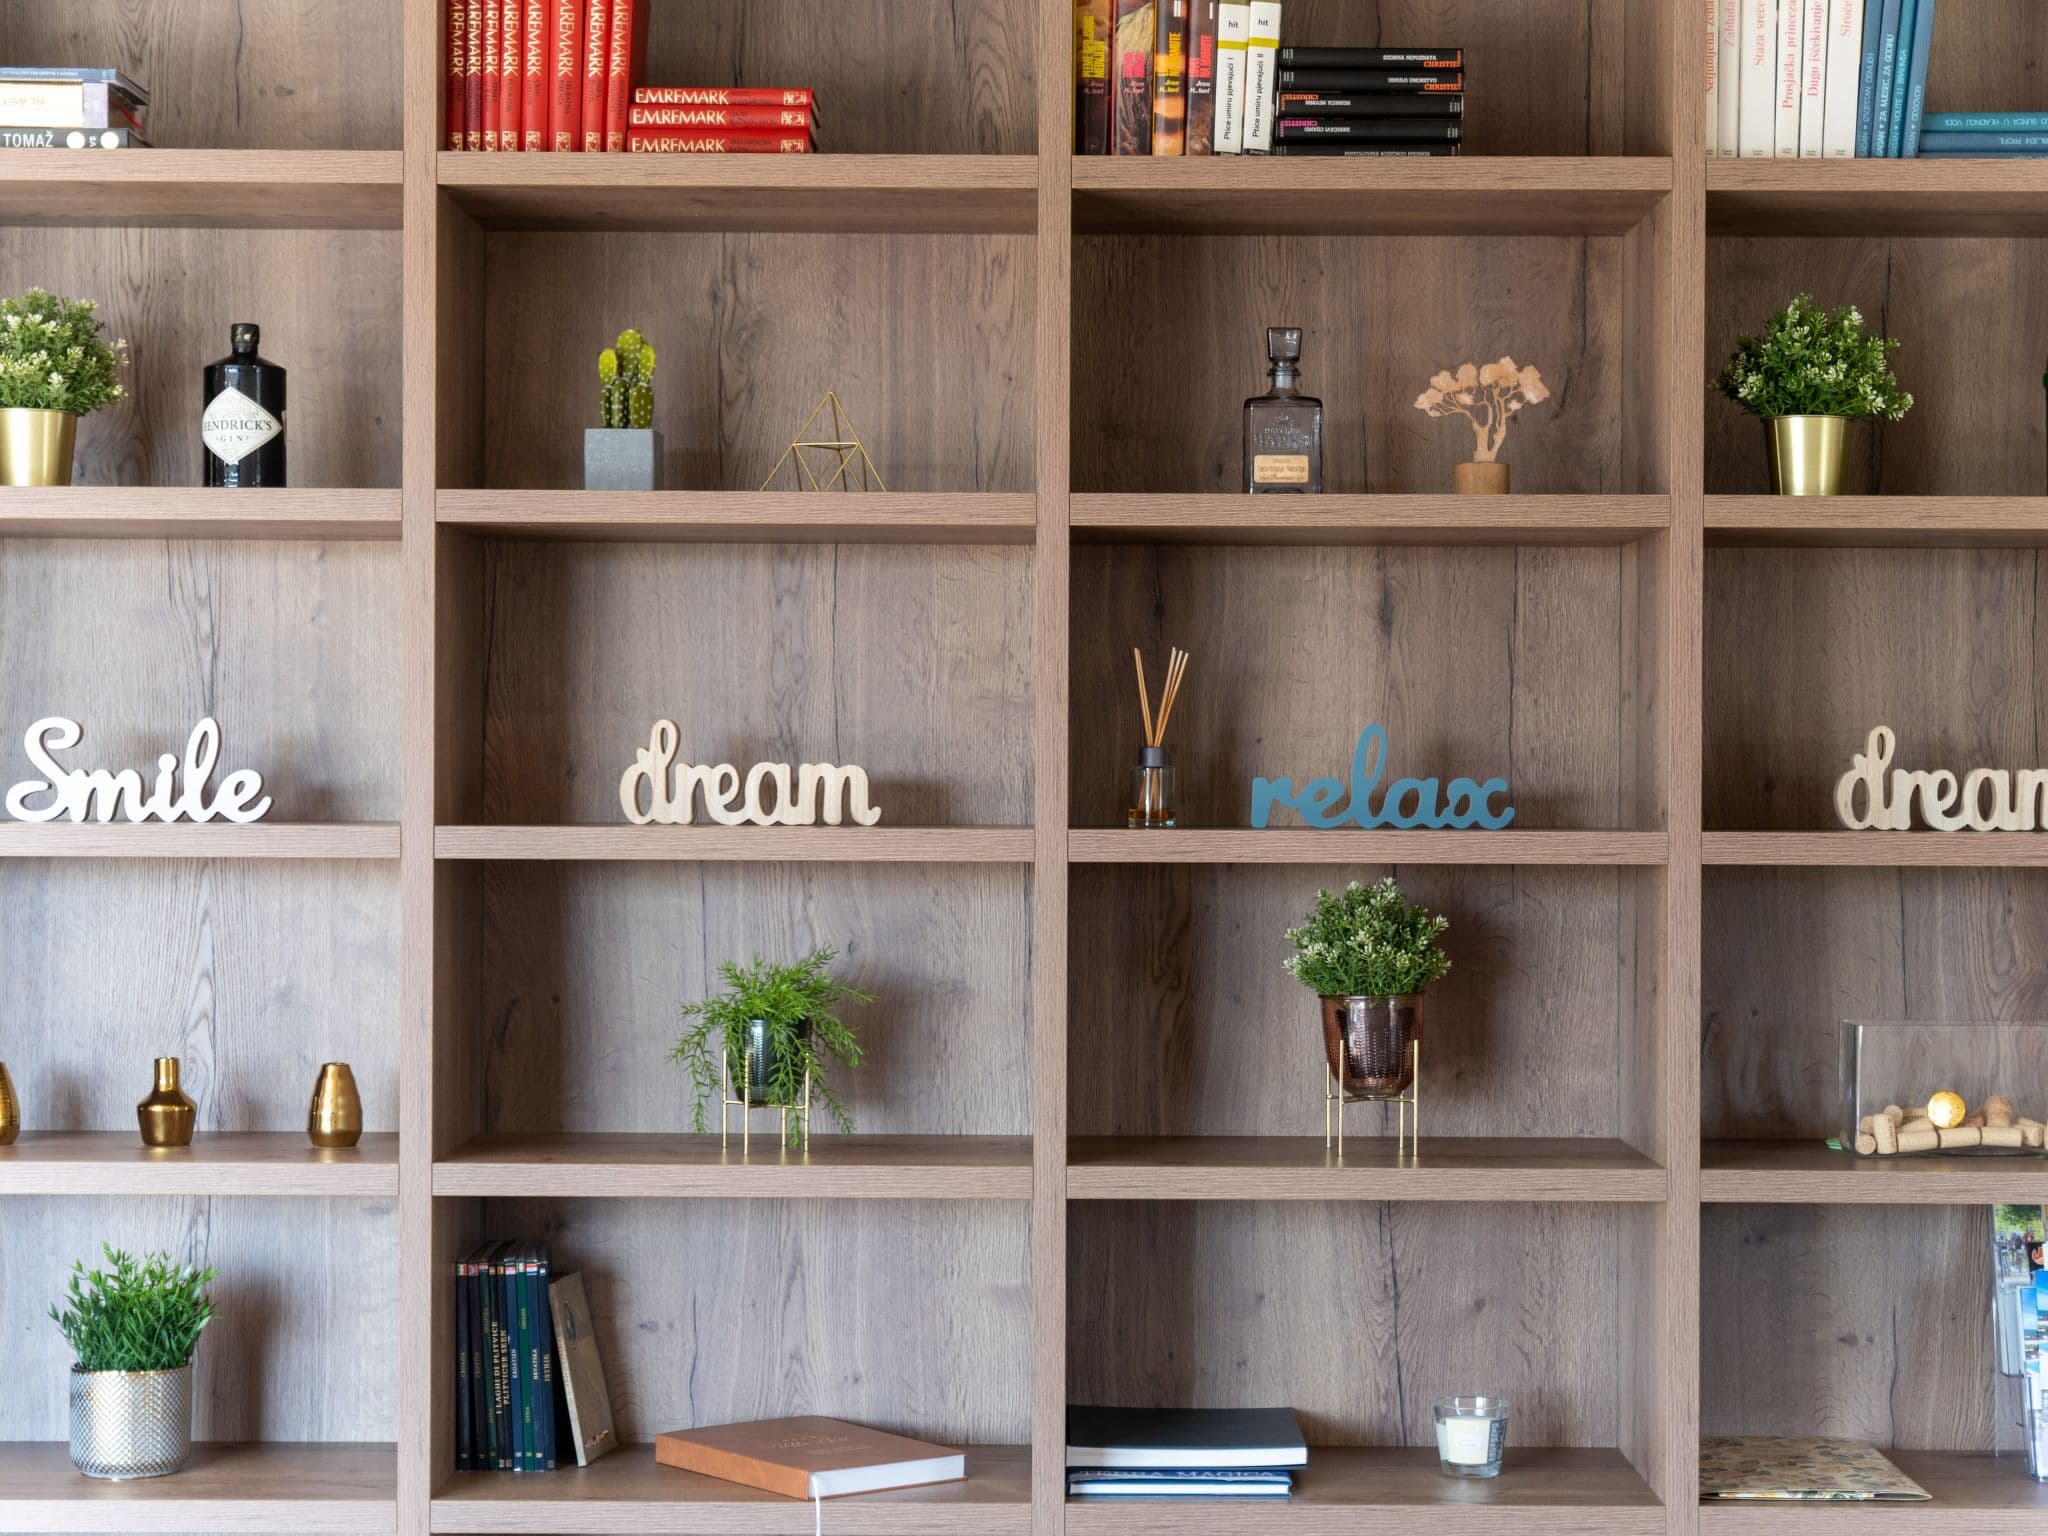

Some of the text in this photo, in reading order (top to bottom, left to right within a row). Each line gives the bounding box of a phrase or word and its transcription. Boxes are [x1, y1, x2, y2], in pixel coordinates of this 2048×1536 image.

[1228, 20, 1238, 29] hit
[1258, 17, 1268, 27] hit
[1753, 35, 1765, 67] Staza
[1782, 0, 1798, 109] Prosjačka princeza
[1808, 0, 1824, 97] Dugo iščekivanje
[1226, 62, 1234, 96] pjevajući
[1255, 60, 1264, 94] pjevajući
[1254, 95, 1262, 117] umiru
[1880, 110, 1888, 122] ZA
[1884, 65, 1892, 77] ZA
[1224, 97, 1233, 119] umiru
[1223, 120, 1232, 140] Ptice
[1252, 118, 1261, 138] Ptice
[1945, 118, 1963, 127] VODI
[2, 130, 54, 148] TOMAŽ
[204, 419, 272, 432] HENDRICK'S
[220, 434, 244, 442] GIN
[5, 717, 272, 823] Smile
[619, 719, 882, 826] dream
[1251, 722, 1515, 830] relax
[492, 1320, 500, 1364] PLITVICE
[494, 1365, 500, 1377] DI
[502, 1354, 510, 1405] PLITVICER
